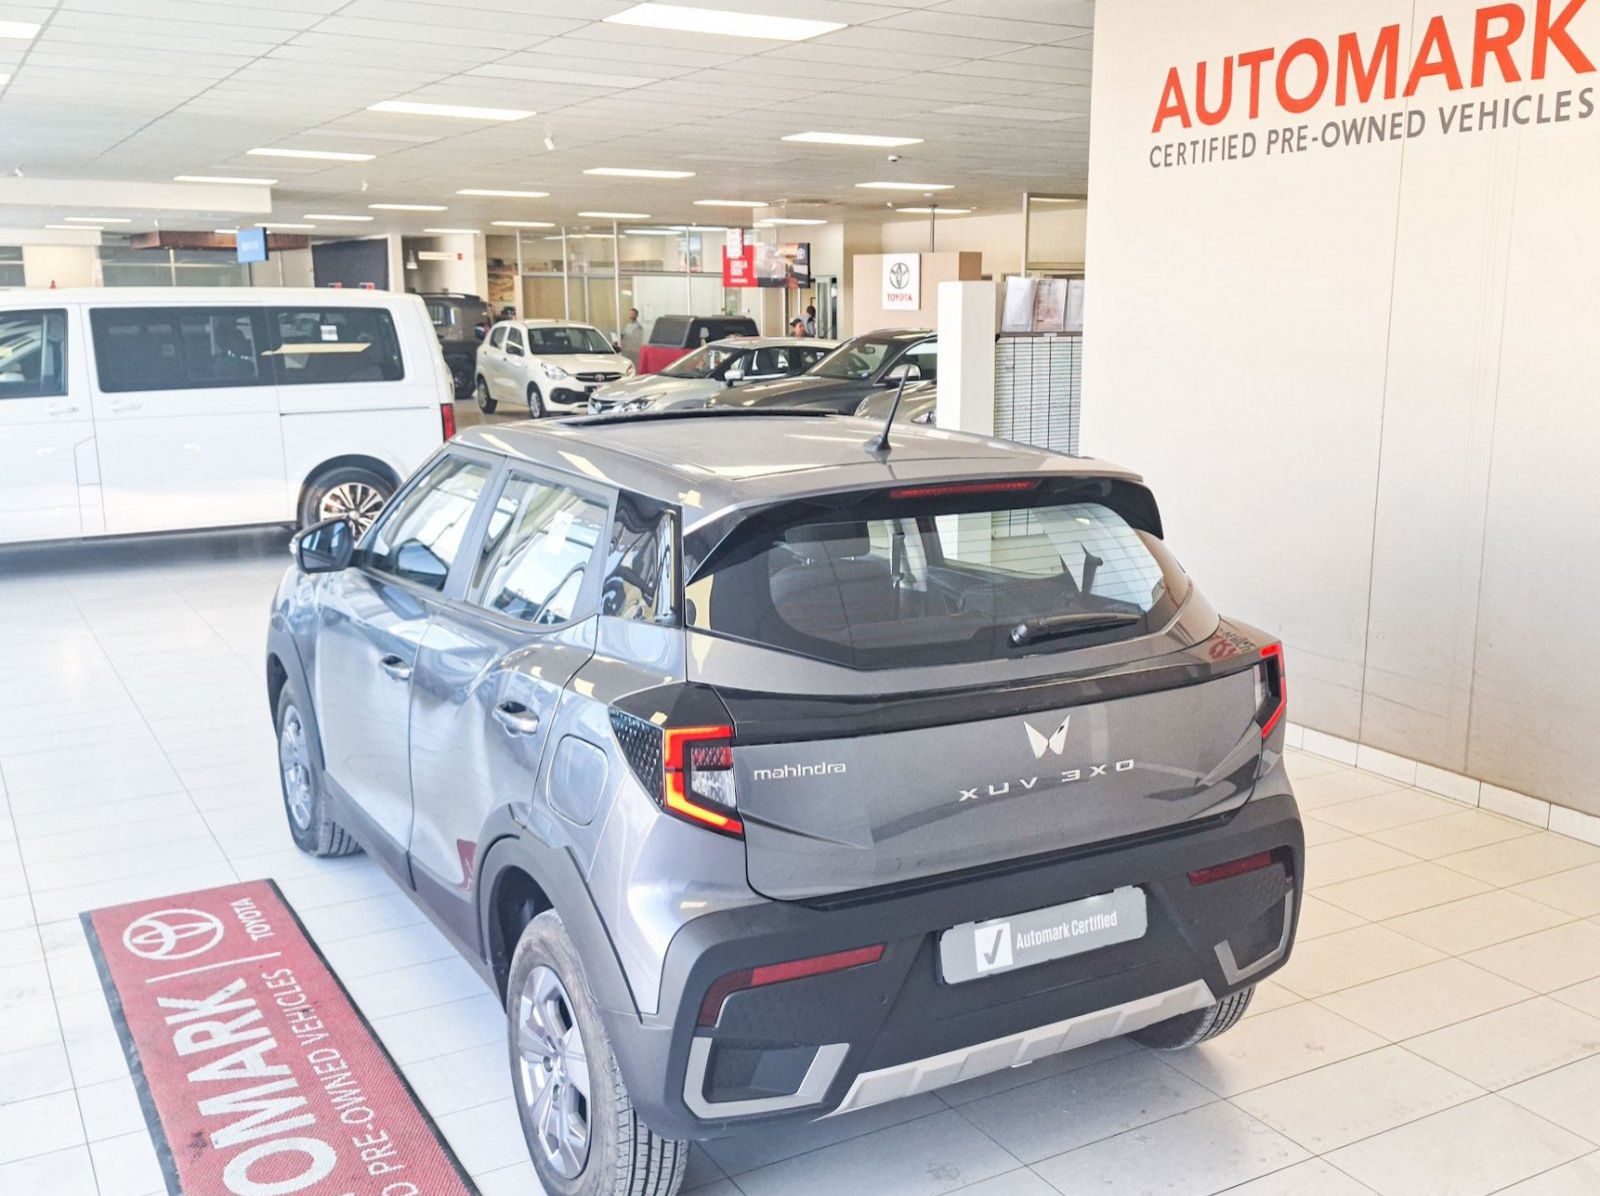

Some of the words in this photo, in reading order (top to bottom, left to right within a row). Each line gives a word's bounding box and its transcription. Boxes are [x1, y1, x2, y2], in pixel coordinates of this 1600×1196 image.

[1151, 0, 1597, 133] AUTOMARK
[1150, 132, 1256, 168] CERTIFIED
[1266, 109, 1426, 155] PRE-OWNED
[1438, 87, 1595, 134] VEHICLES
[887, 292, 913, 301] TOYOTA
[753, 760, 847, 781] mahindra
[958, 776, 1038, 802] XUV
[1061, 759, 1135, 783] 3XO
[230, 897, 275, 942] TOYOTA
[1016, 924, 1070, 949] Automark
[1072, 911, 1117, 936] Certified
[261, 968, 328, 1046] VEHICLES
[157, 977, 350, 1196] OMARK
[308, 1048, 405, 1175] PRE-OWNED
